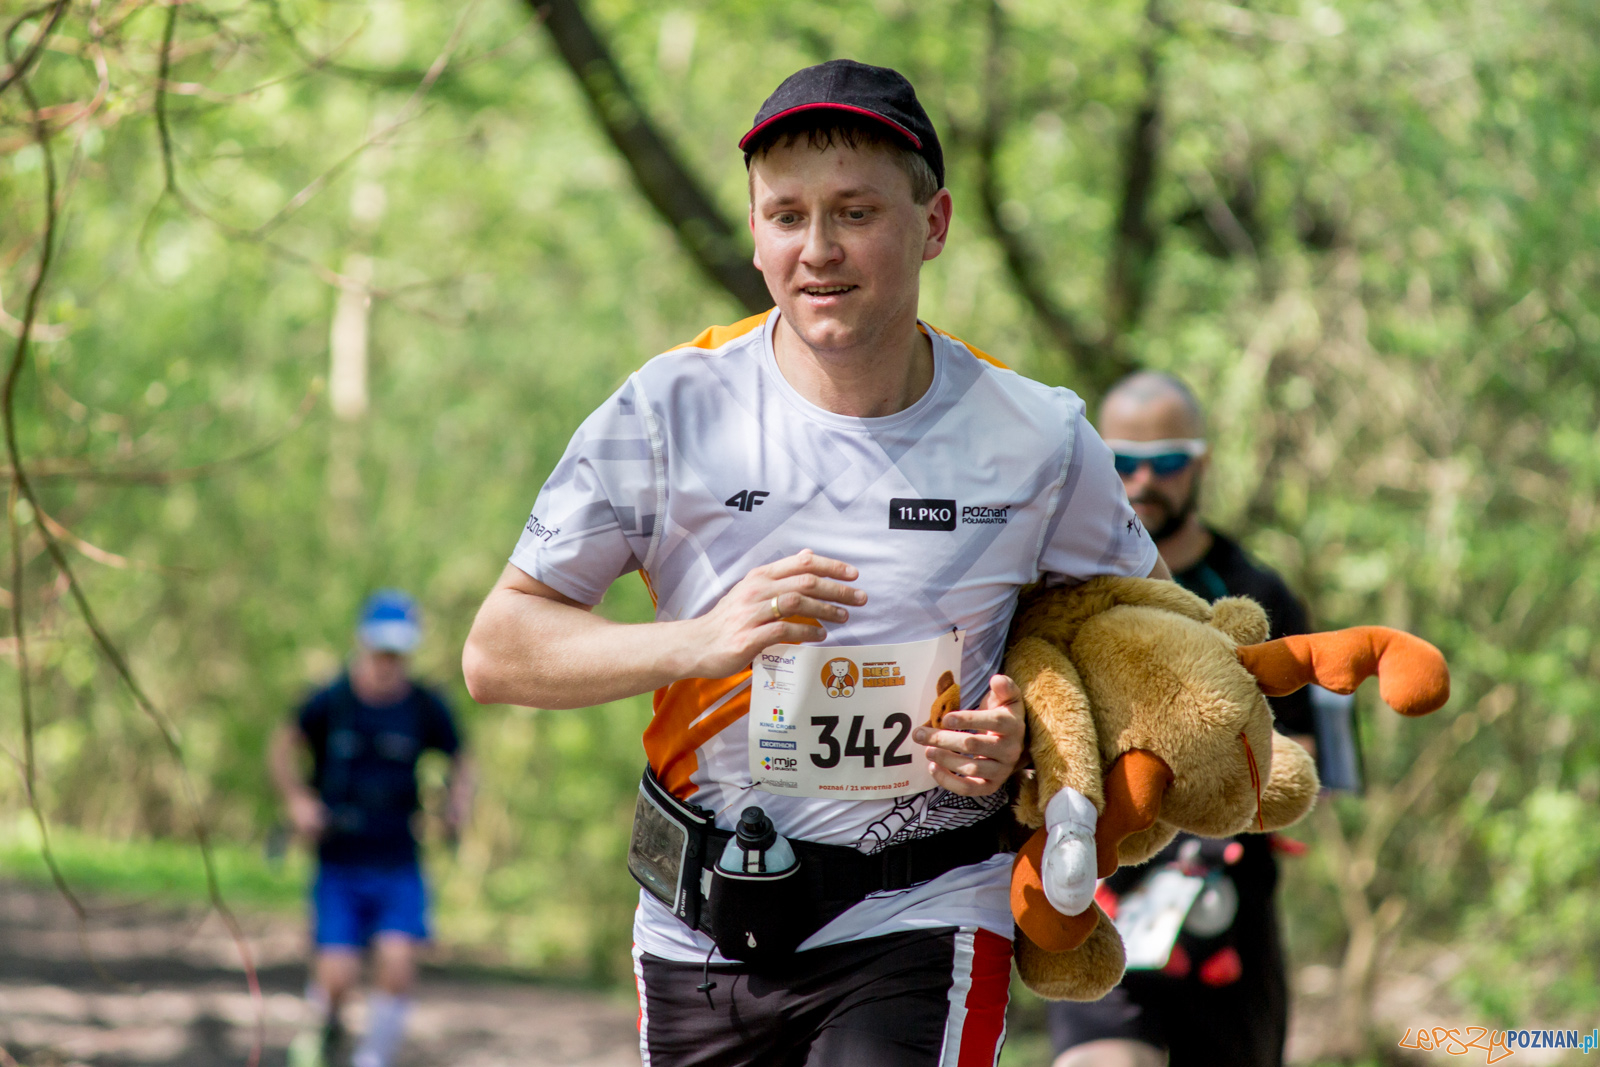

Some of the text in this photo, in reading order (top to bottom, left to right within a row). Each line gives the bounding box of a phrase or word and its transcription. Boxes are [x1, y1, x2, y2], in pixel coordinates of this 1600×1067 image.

[725, 490, 770, 512] 4F
[898, 507, 951, 521] 11. PKO
[761, 740, 795, 749] DECATHLON
[809, 712, 912, 769] 342
[774, 757, 798, 768] mjp
[893, 780, 910, 789] 2018
